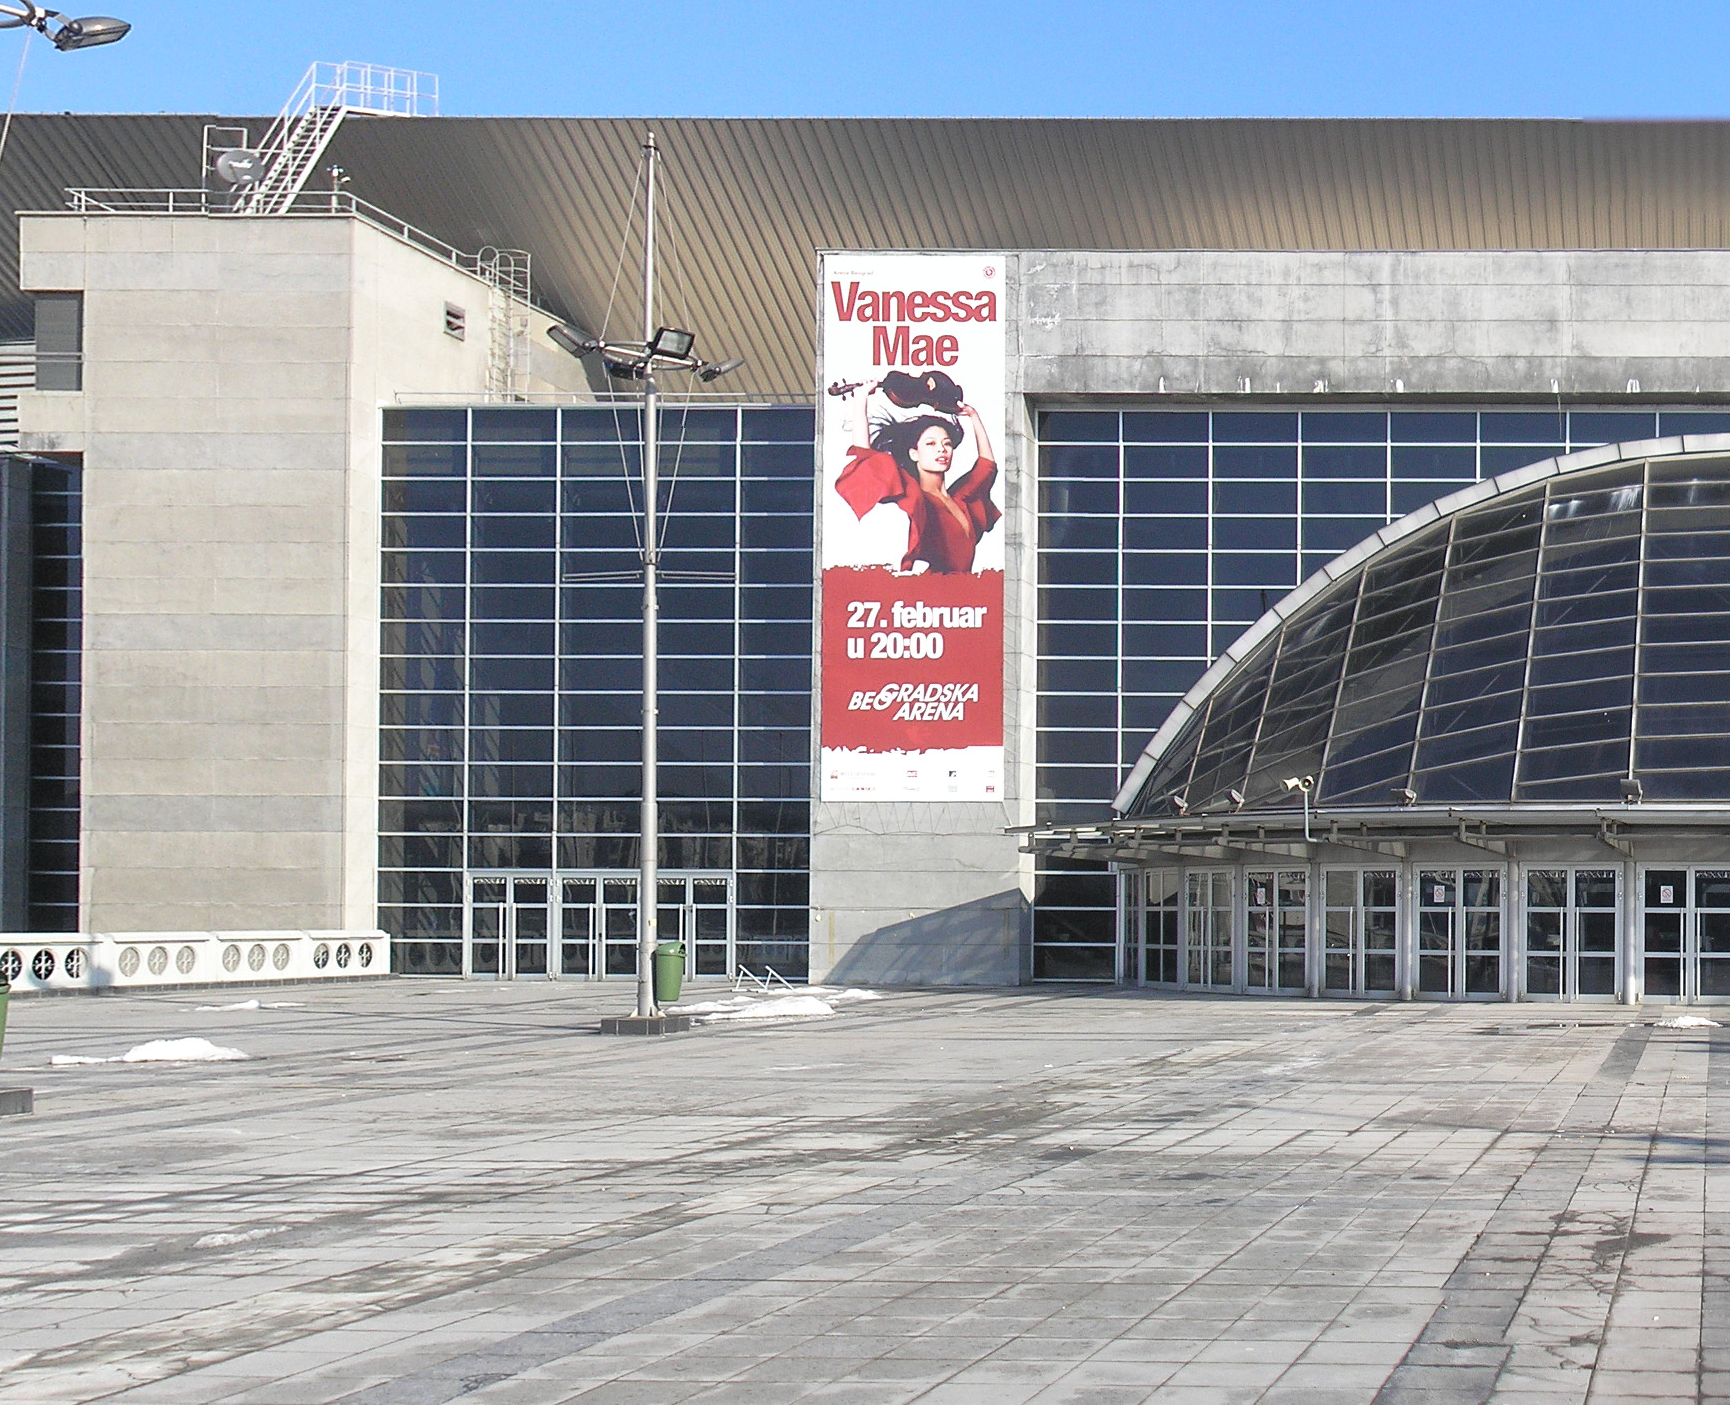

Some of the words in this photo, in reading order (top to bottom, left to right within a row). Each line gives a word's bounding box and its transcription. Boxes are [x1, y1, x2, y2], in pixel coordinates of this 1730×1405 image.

[831, 281, 997, 322] Vanessa
[873, 326, 959, 366] Mae
[847, 601, 888, 628] 27.
[891, 600, 987, 628] februar
[847, 637, 865, 659] u
[870, 632, 944, 659] 20:00
[847, 682, 979, 713] BEOGRADSKA
[892, 701, 965, 722] ARENA
